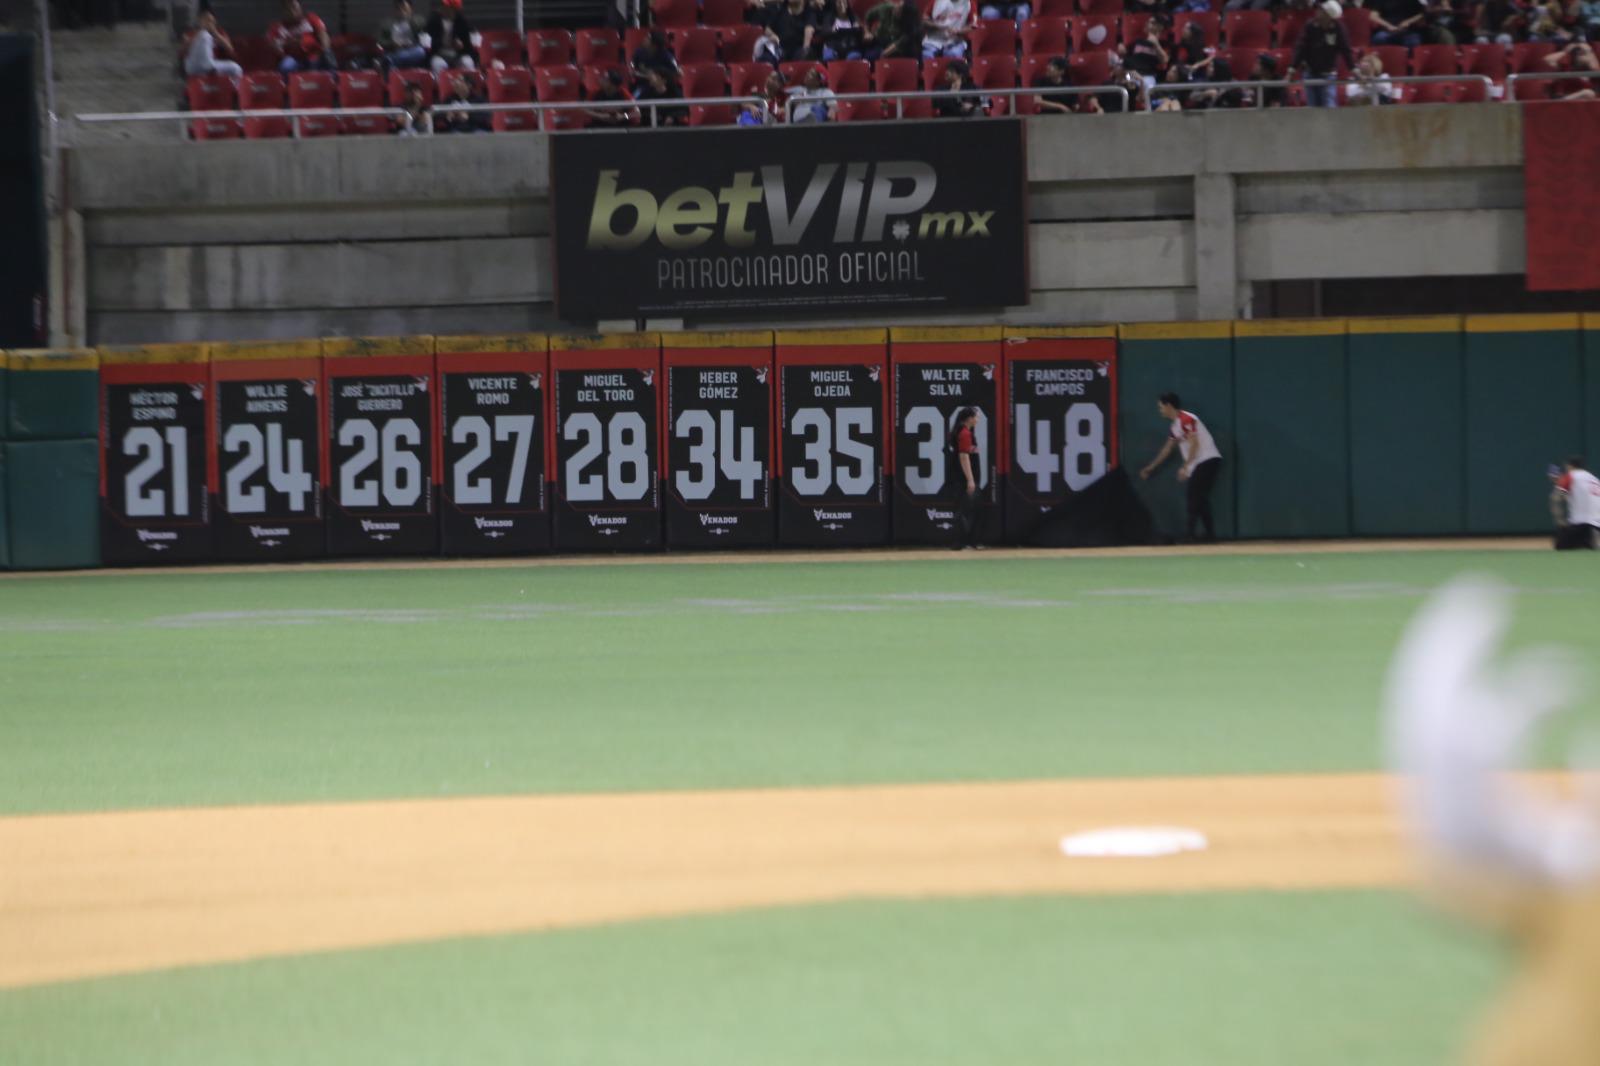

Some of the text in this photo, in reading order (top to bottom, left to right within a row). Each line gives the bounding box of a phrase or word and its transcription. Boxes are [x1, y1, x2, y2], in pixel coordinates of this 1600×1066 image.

[659, 251, 924, 288] PATROCINADOR OFICIAL
[584, 375, 626, 386] MIGUEL
[700, 372, 737, 383] HEBER
[811, 371, 853, 382] MIGUEL
[922, 369, 969, 380] WALTER
[1027, 369, 1093, 381] FRANCISCO
[341, 382, 363, 397] JOSÉ
[468, 378, 517, 389] VICENTE
[930, 384, 962, 395] SILVA
[1036, 383, 1084, 395] CAMPOS
[246, 385, 287, 397] WILLIE
[578, 389, 634, 402] DEL TORO
[699, 384, 738, 398] GÓMEZ
[814, 385, 850, 396] OJEDA
[477, 393, 509, 404] ROMO
[791, 407, 874, 495] 35
[1016, 403, 1106, 492] 48
[452, 415, 534, 504] 27
[564, 412, 648, 501] 28
[676, 410, 762, 499] 34
[224, 423, 312, 513] 24
[339, 418, 421, 506] 26
[123, 427, 188, 516] 21
[589, 515, 627, 526] VENADOS
[700, 513, 737, 525] VENADOS
[814, 509, 851, 520] VENADOS
[475, 517, 513, 528] VENADOS
